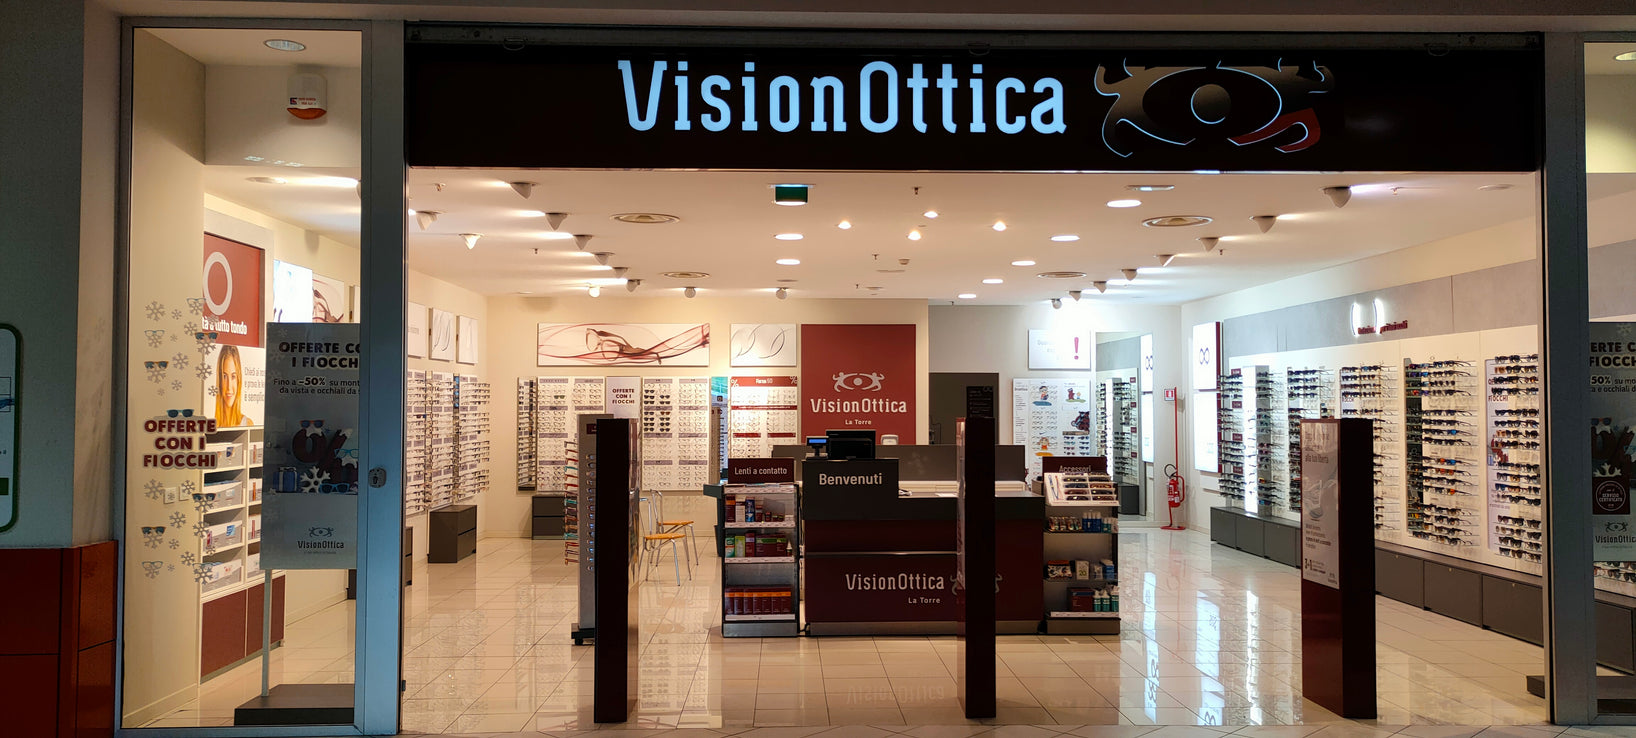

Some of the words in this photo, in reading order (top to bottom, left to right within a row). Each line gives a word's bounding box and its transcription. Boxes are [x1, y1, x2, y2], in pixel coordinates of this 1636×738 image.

[617, 60, 1067, 134] VisionOttica
[230, 321, 248, 335] tondo
[278, 342, 339, 354] OFFERTE
[1590, 342, 1622, 353] ERTE
[291, 357, 296, 368] I
[273, 378, 290, 386] Fino
[279, 386, 289, 394] da
[291, 386, 309, 394] vista
[317, 386, 346, 395] occhiali
[347, 386, 356, 394] da
[810, 398, 907, 413] VisionOttica
[144, 419, 216, 433] OFFERTE
[154, 437, 193, 450] CON
[198, 437, 205, 450] I
[143, 454, 216, 468] FIOCCHI
[734, 467, 752, 475] Lenti
[758, 467, 788, 475] contatto
[819, 472, 882, 486] Benvenuti
[297, 540, 345, 549] VisionOttica
[845, 573, 945, 591] VisionOttica
